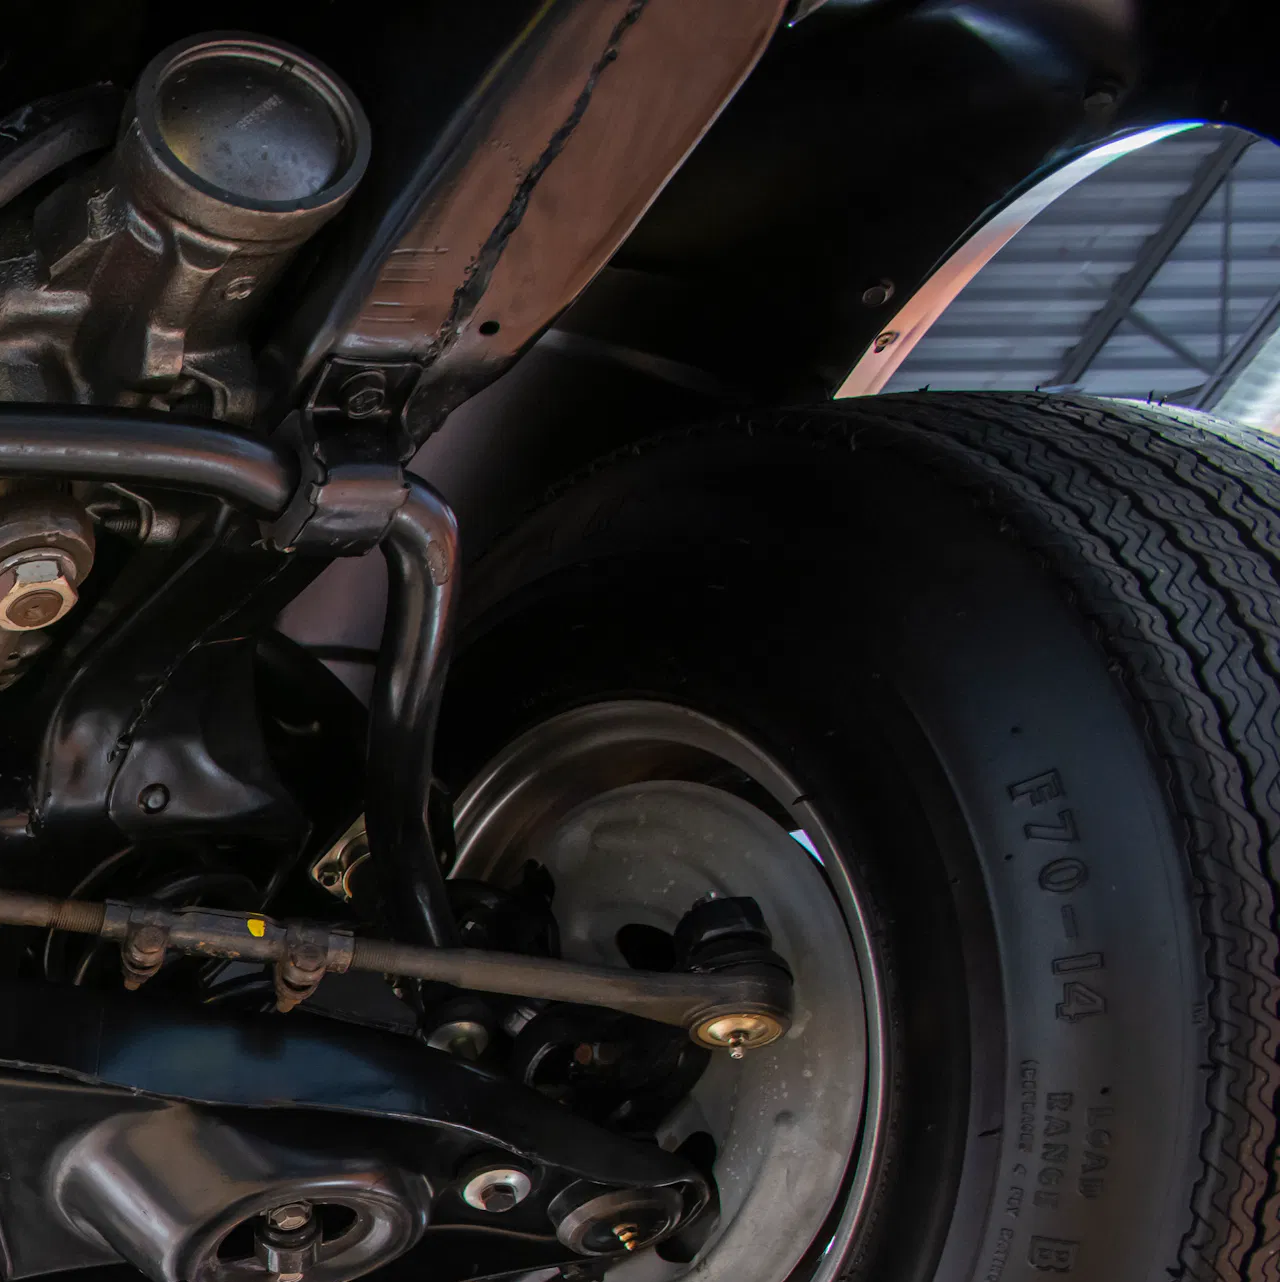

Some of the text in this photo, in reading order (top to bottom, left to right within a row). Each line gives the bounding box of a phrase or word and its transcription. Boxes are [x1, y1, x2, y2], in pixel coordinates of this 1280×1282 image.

[1006, 767, 1108, 1023] F70-14
[1078, 1106, 1115, 1200] LOAD
[1027, 1234, 1081, 1274] B
